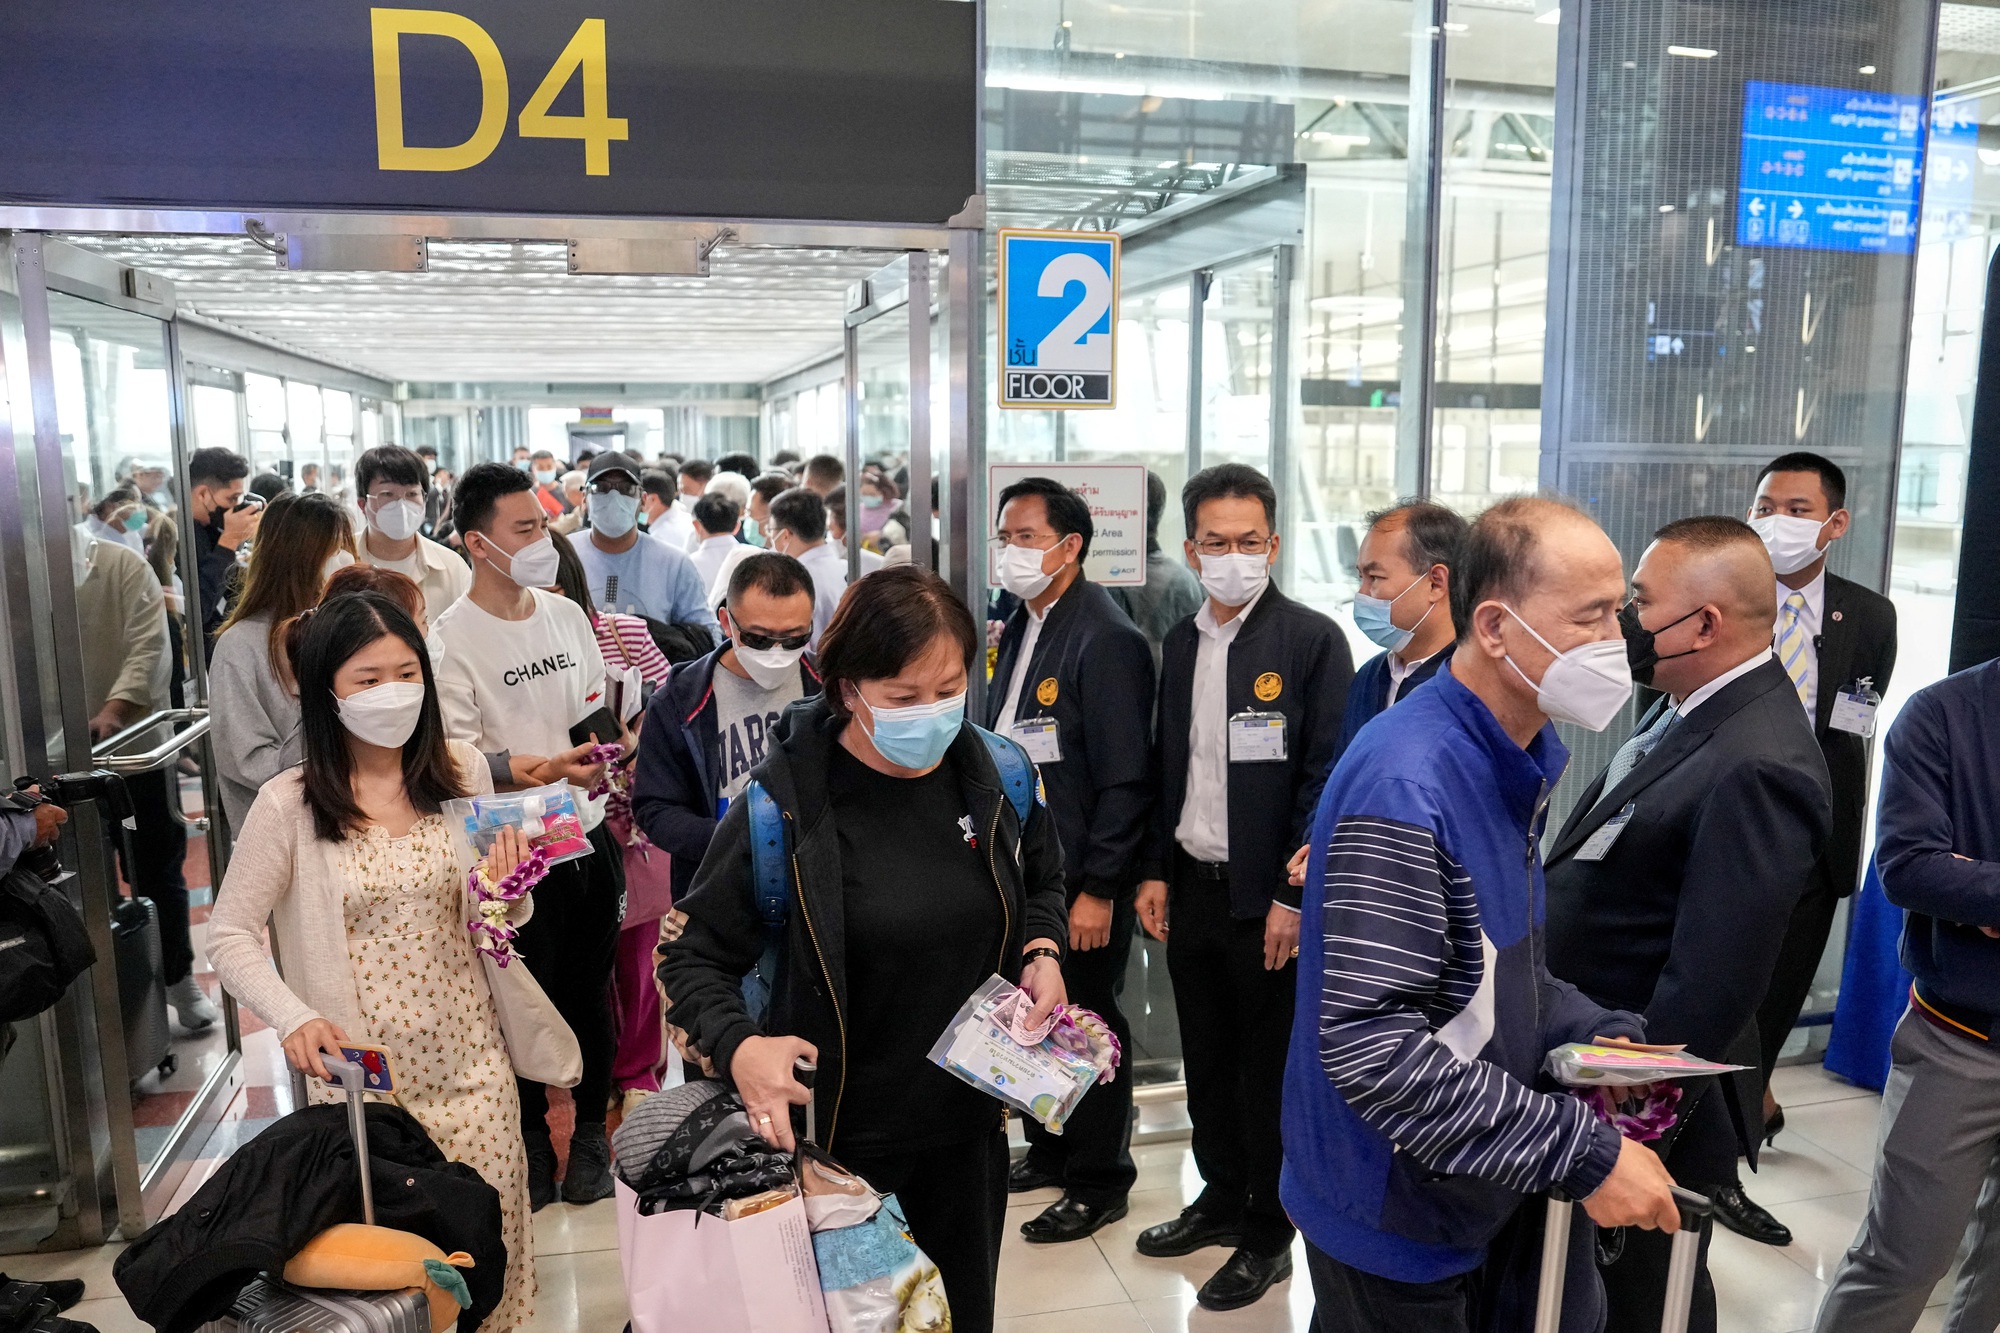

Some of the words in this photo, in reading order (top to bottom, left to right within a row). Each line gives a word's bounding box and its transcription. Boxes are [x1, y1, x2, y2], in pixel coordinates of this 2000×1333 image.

[370, 7, 629, 177] D4
[1037, 252, 1111, 367] 2
[1009, 338, 1035, 365] ชั้น
[1009, 374, 1085, 399] FLOOR
[1101, 528, 1123, 537] Area
[1092, 548, 1137, 558] permission
[504, 652, 576, 686] CHANEL
